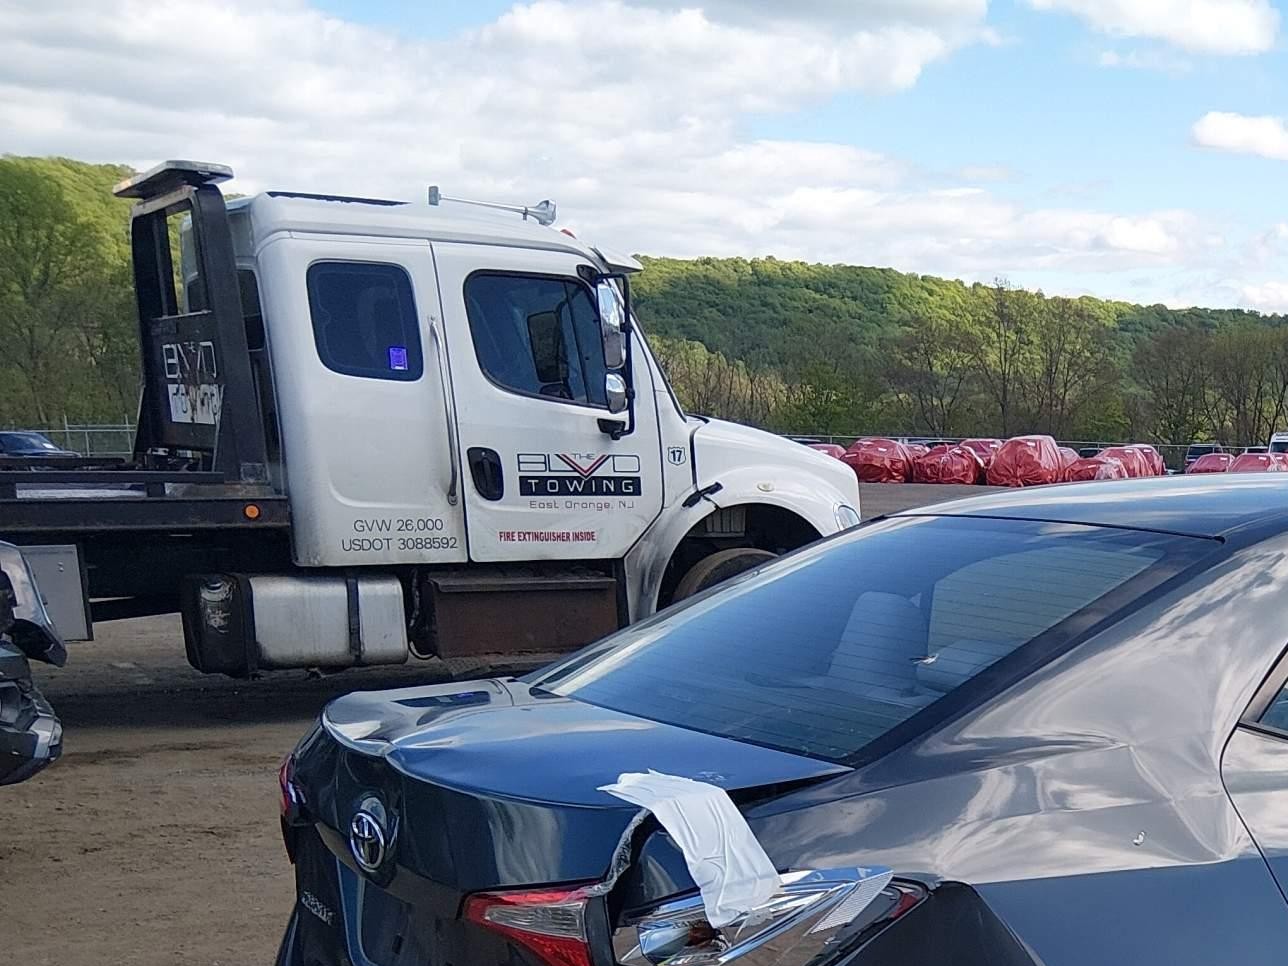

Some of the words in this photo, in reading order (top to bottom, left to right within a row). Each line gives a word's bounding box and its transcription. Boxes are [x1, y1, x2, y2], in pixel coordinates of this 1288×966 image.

[670, 449, 683, 462] 17
[527, 479, 634, 493] TOWING
[529, 500, 559, 509] East
[565, 500, 614, 511] Orange,
[619, 500, 634, 509] NJ
[353, 519, 392, 532] GVW
[396, 518, 444, 532] 26,000
[499, 531, 516, 543] FIRE
[517, 531, 571, 543] EXTINGUISHER
[572, 531, 596, 542] INSIDE
[341, 537, 393, 552] USDOT
[397, 536, 459, 551] 3088592
